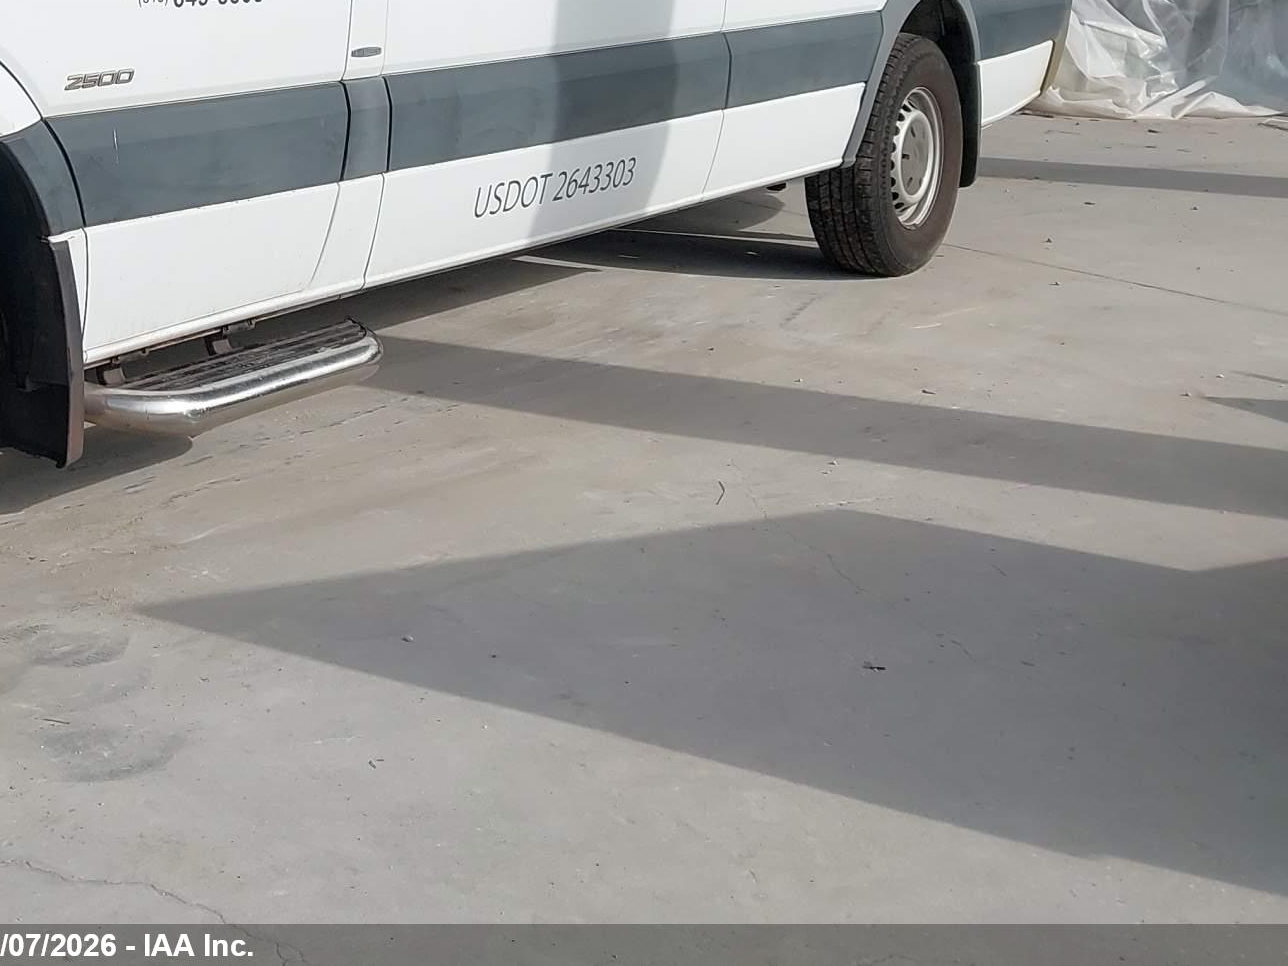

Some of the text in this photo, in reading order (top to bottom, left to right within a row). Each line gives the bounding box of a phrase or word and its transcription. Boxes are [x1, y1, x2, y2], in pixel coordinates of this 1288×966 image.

[64, 68, 135, 90] 2500
[474, 156, 637, 218] USDOT 2643303
